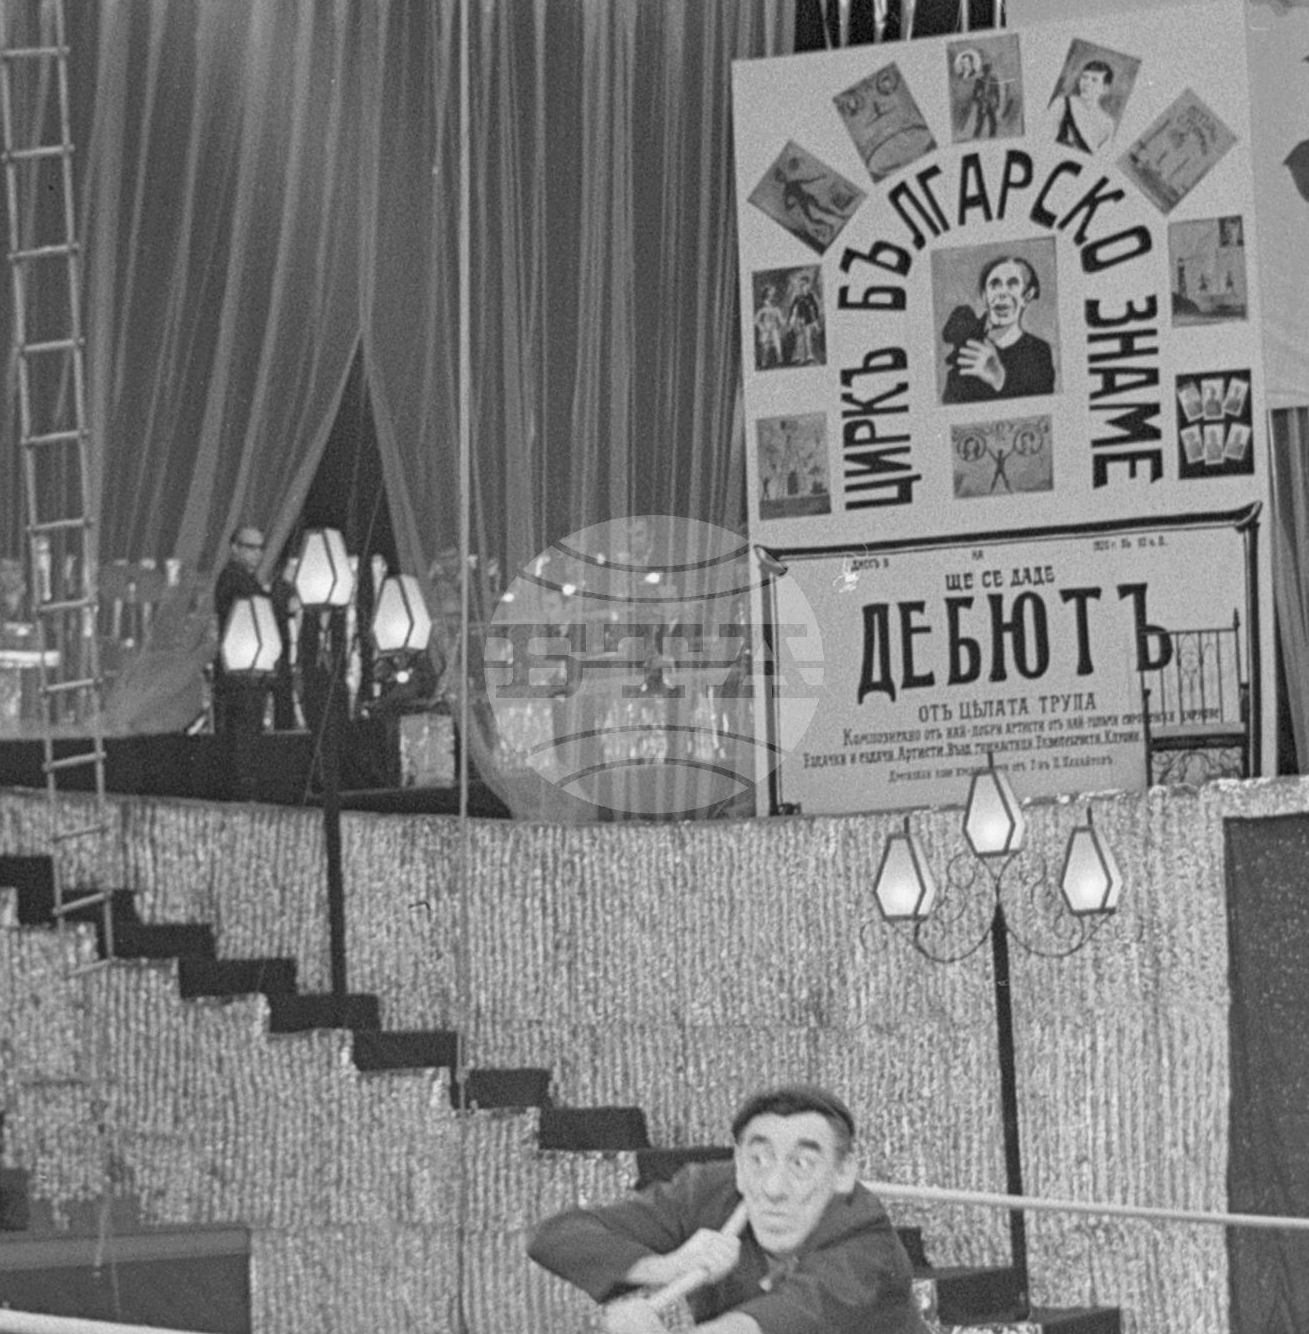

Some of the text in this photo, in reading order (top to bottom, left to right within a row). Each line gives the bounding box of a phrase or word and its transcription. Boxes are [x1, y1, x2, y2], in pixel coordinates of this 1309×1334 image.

[837, 149, 1164, 510] ЦИРКЪ БЪЛГАРСКО ЗНАМЕ
[945, 565, 1055, 591] ЩЕ СЕ ДАДЕ
[856, 581, 1175, 705] ДЕБЮТЪ
[918, 703, 953, 723] ОТЪ
[1038, 692, 1098, 714] ТРУПА
